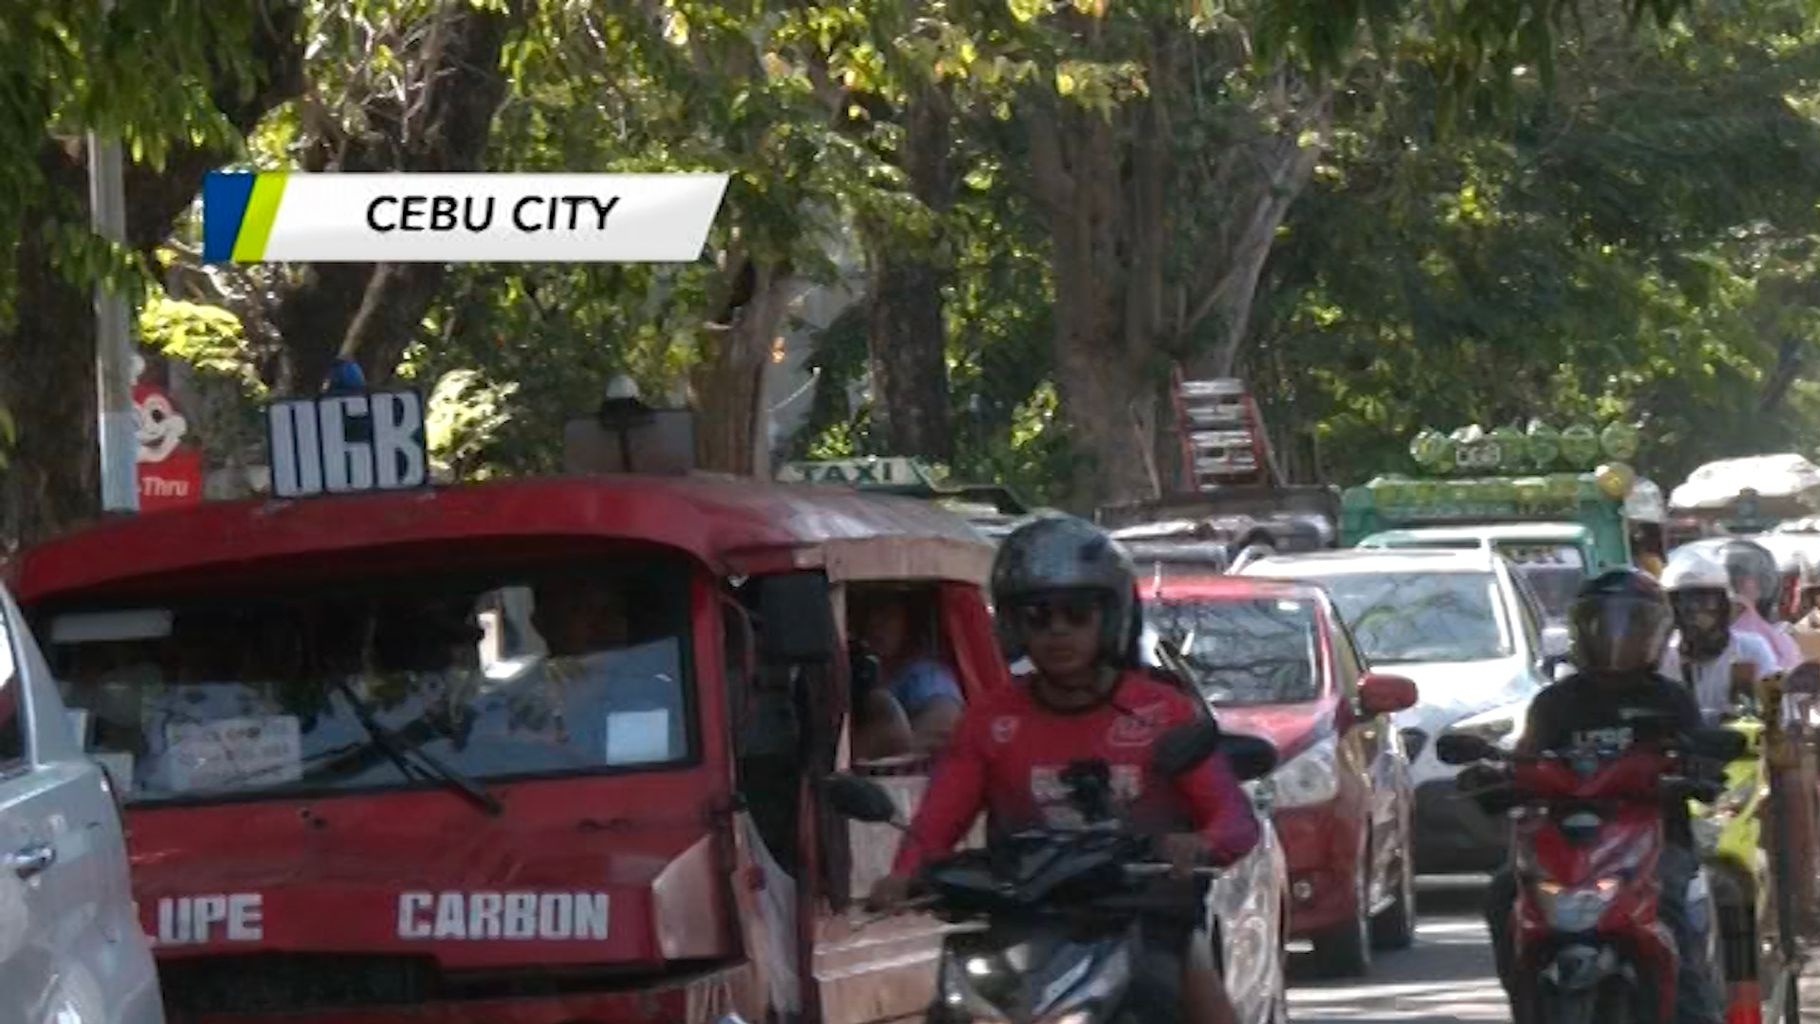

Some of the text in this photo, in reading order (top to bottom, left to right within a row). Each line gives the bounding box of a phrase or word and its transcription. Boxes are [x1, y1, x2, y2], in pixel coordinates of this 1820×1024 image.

[800, 461, 894, 484] TAXI
[152, 892, 609, 945] UPE CARBON
